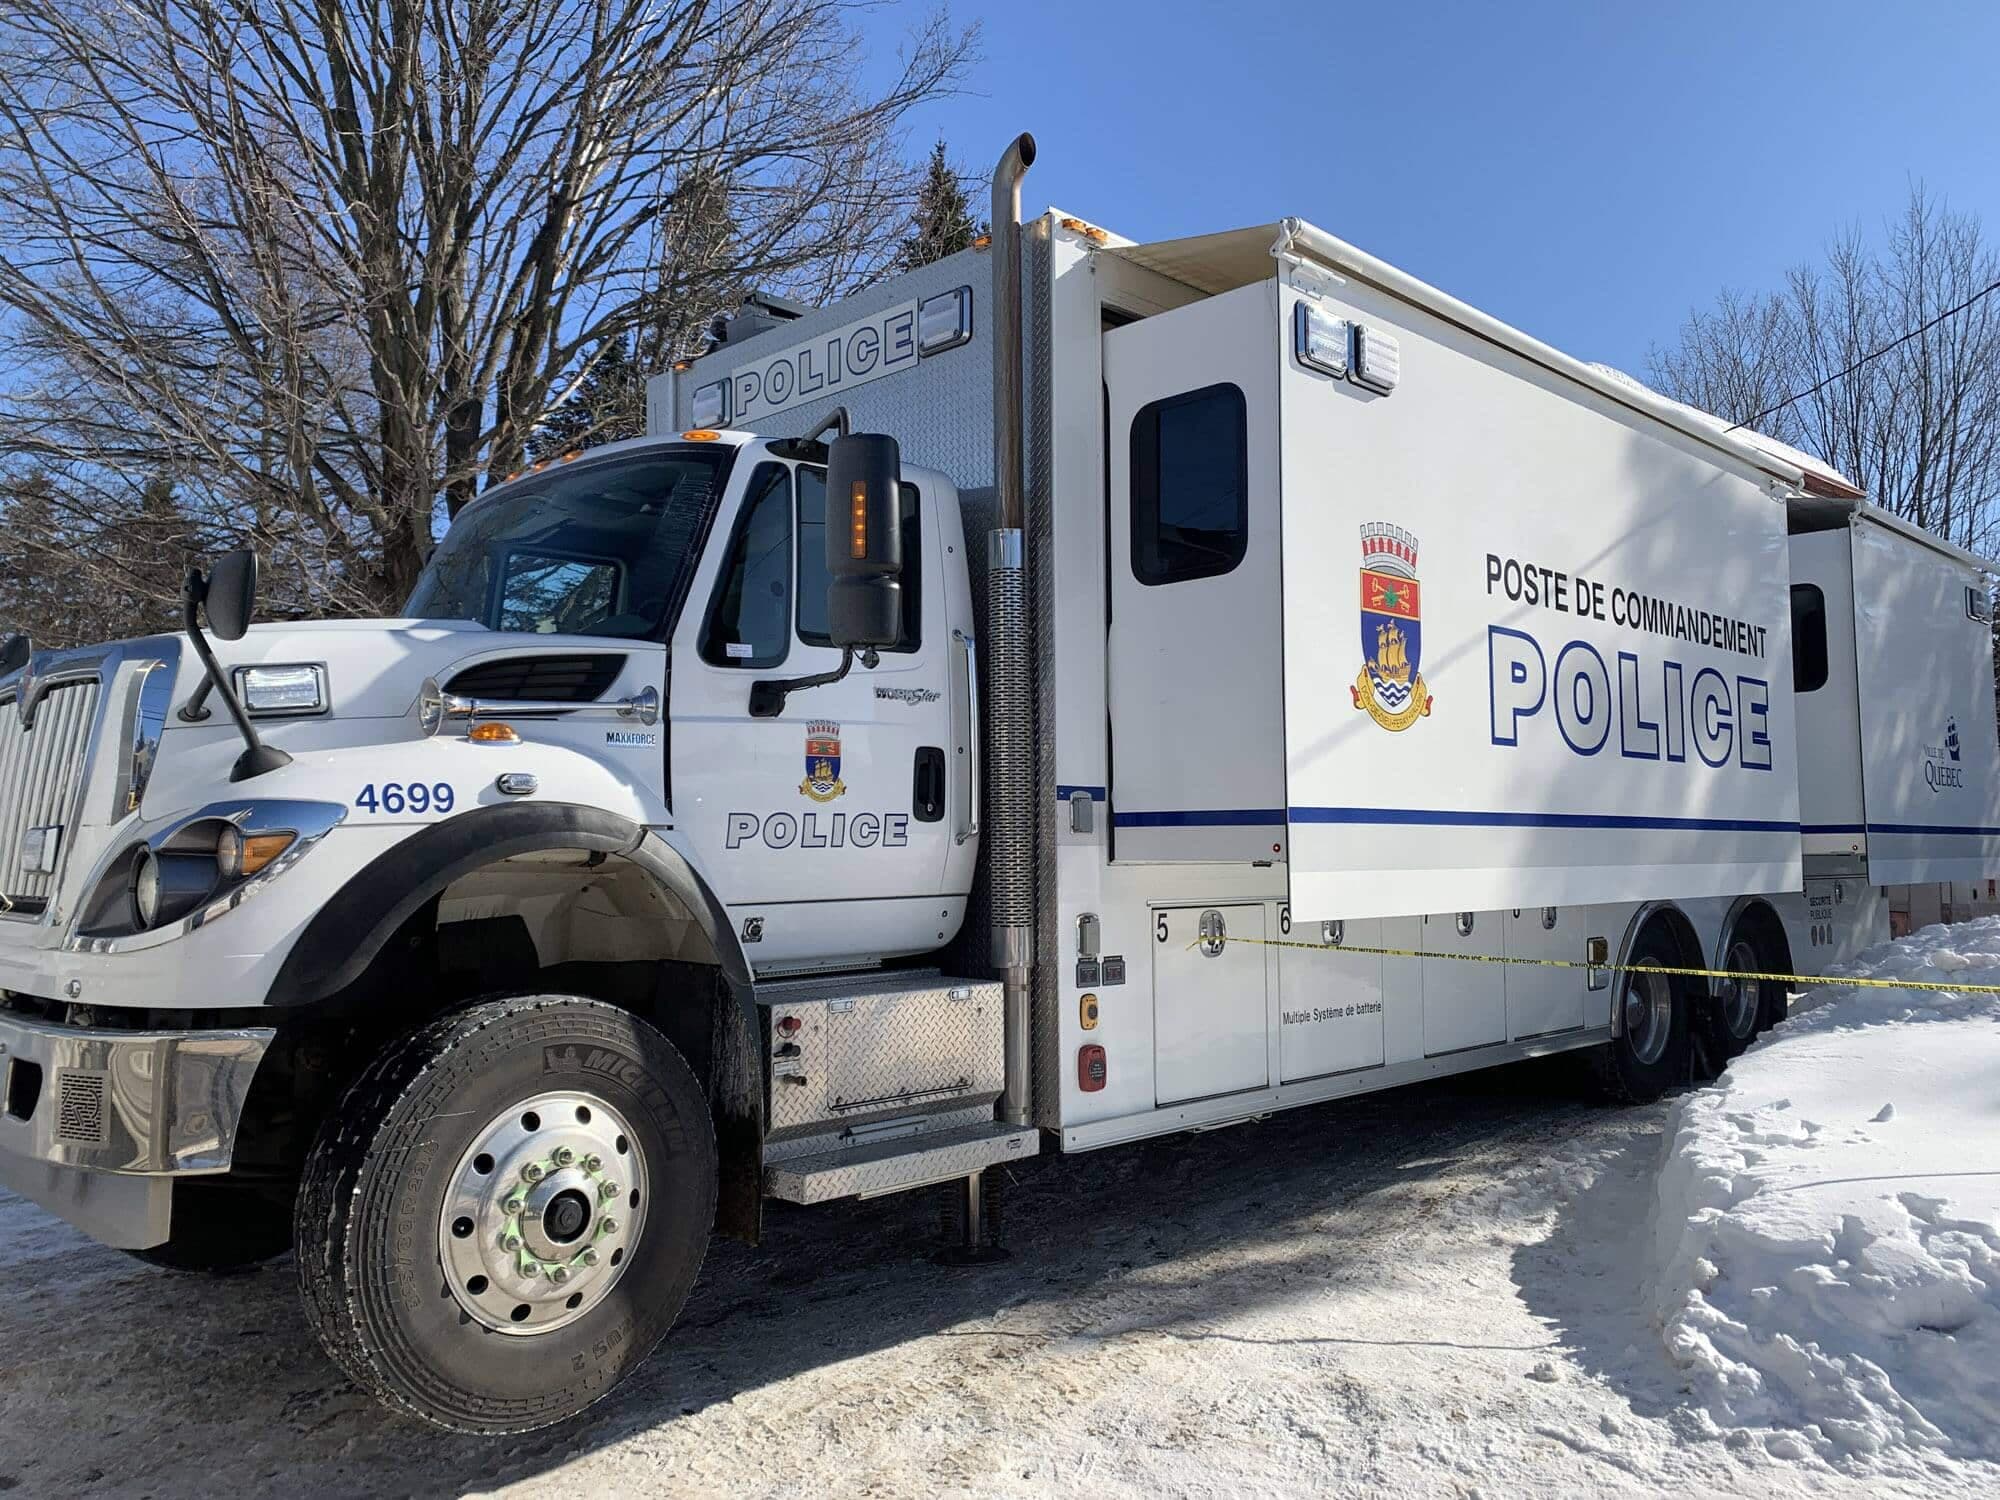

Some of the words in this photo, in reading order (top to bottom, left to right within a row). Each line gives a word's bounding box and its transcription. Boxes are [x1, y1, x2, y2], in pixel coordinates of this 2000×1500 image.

[735, 311, 913, 416] POLICE
[1486, 552, 1567, 612] POSTE
[1575, 578, 1606, 621] DE
[1611, 587, 1767, 659] COMMANDEMENT
[1487, 624, 1773, 772] POLICE
[355, 783, 453, 813] 4699
[725, 812, 909, 849] POLICE
[1156, 913, 1169, 942] 5
[1280, 907, 1291, 935] 6
[1283, 1010, 1311, 1025] Multiple
[1313, 1007, 1343, 1022] Système
[1345, 1004, 1354, 1016] de
[1356, 1001, 1381, 1015] batterie
